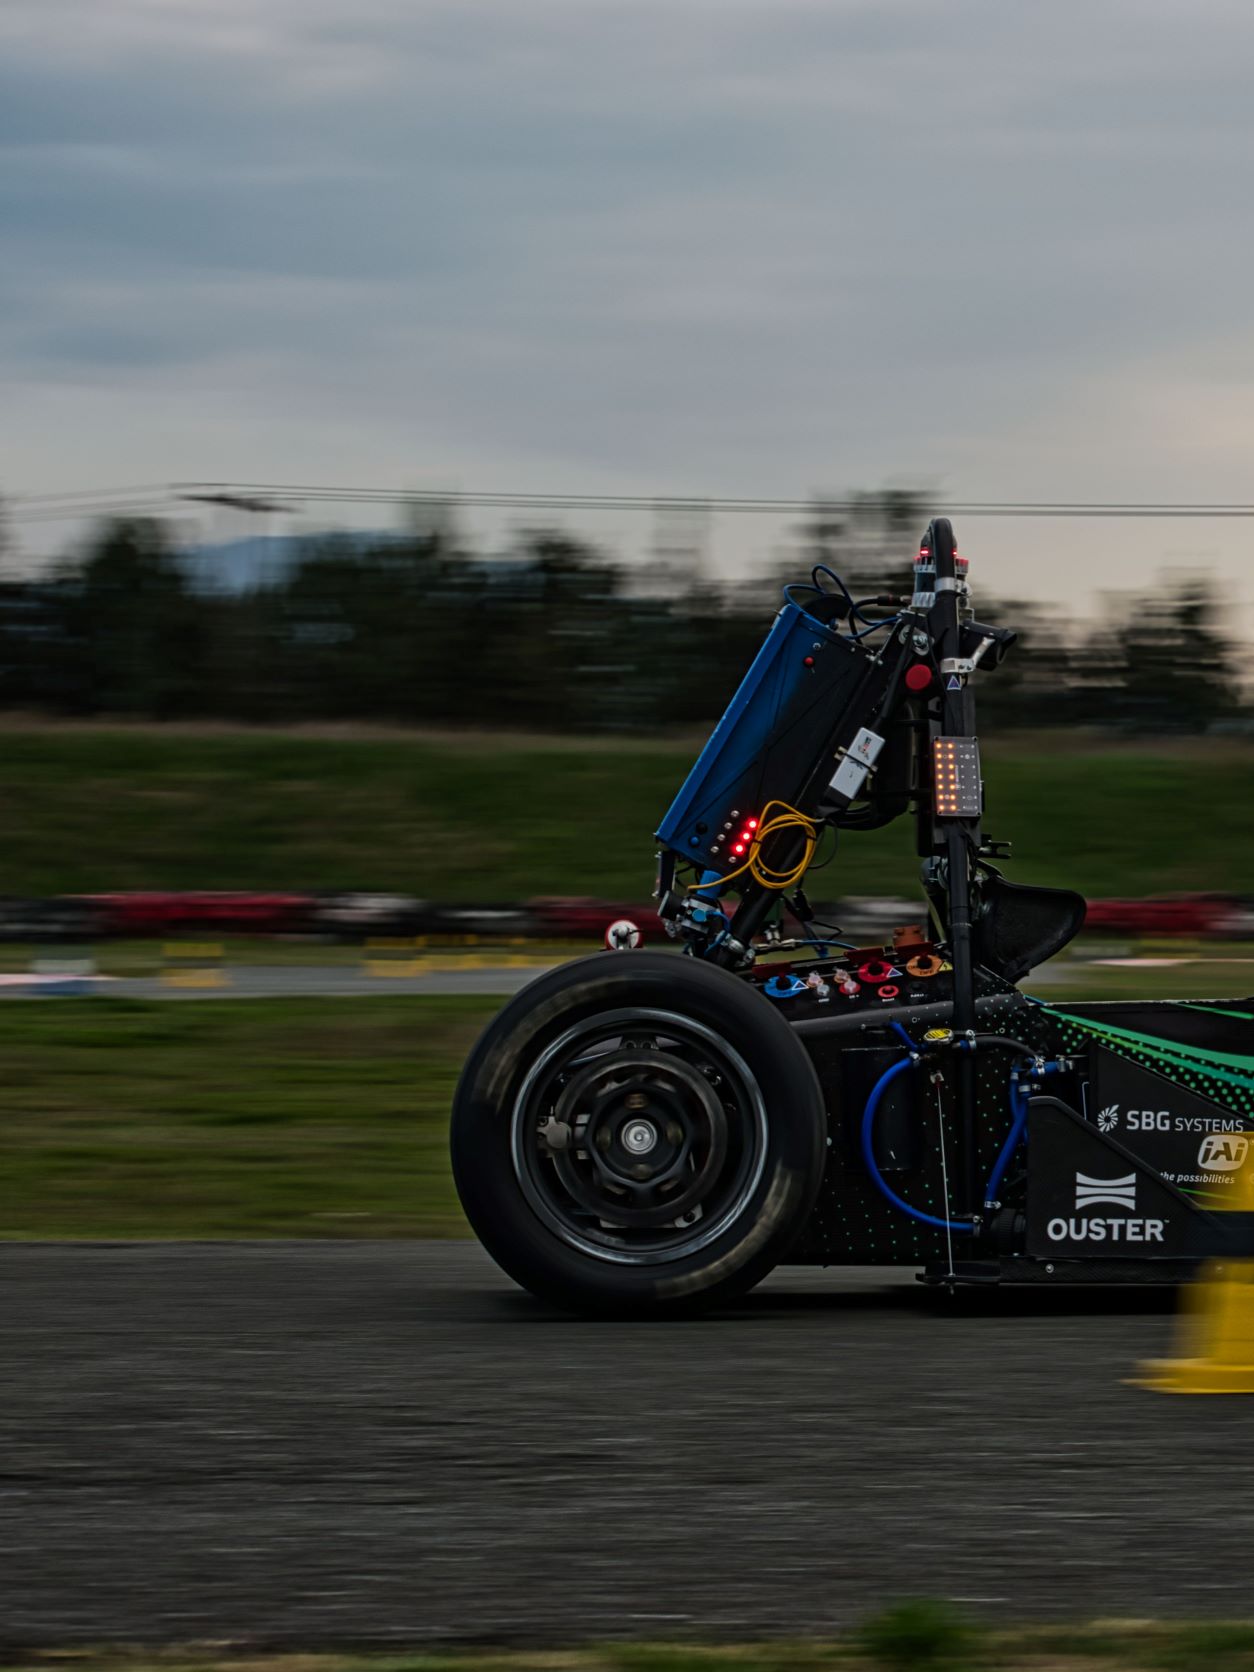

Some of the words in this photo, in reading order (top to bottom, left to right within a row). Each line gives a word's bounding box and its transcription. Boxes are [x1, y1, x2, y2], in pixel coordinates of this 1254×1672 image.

[1126, 1110, 1170, 1131] SBG
[1174, 1117, 1244, 1133] SYSTEMS
[1176, 1173, 1235, 1184] possibilities
[1046, 1218, 1165, 1241] OUSTER
